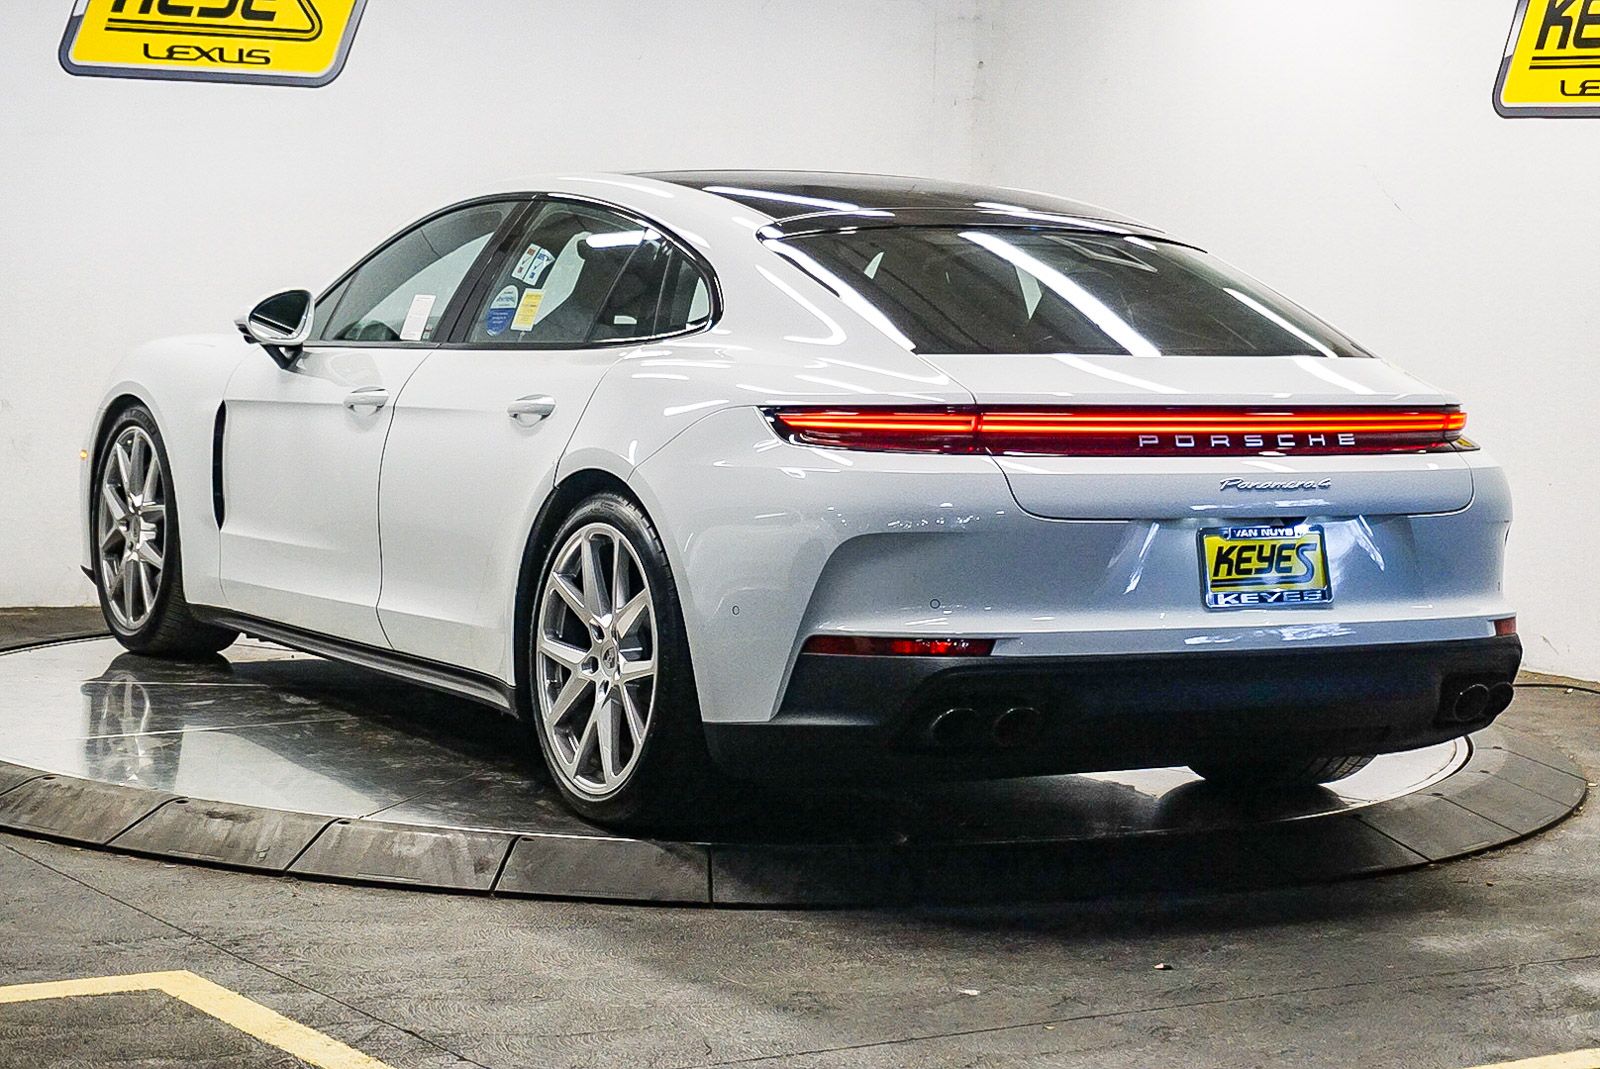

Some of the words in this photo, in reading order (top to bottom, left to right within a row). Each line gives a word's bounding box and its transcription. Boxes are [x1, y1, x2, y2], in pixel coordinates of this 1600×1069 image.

[143, 43, 271, 65] LEXUS
[1138, 433, 1356, 448] PORSCHE
[1219, 477, 1316, 491] Panamera
[1234, 528, 1258, 538] VAN
[1212, 543, 1318, 579] KEYES
[1217, 591, 1322, 605] KEYES
